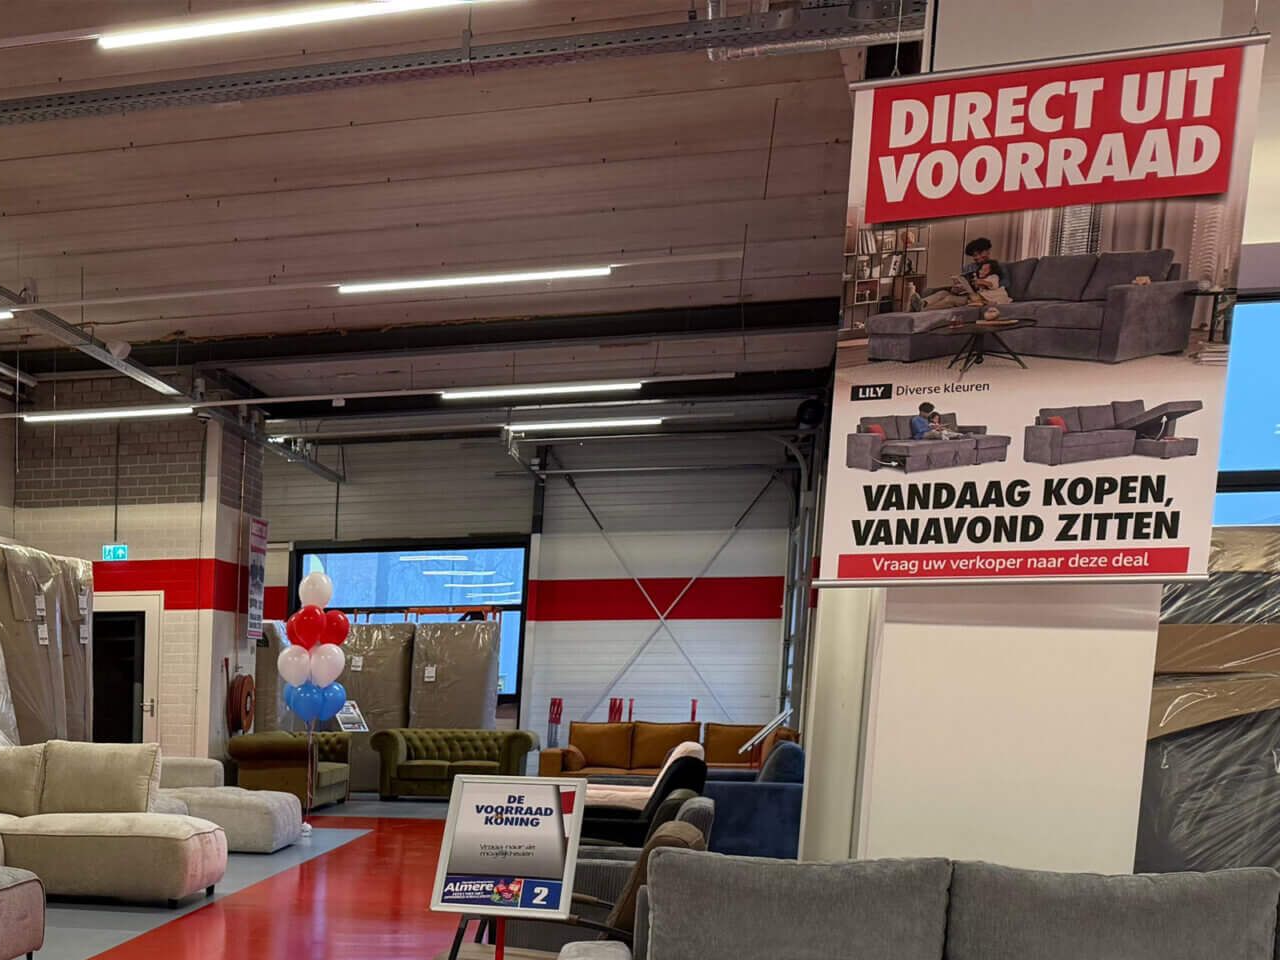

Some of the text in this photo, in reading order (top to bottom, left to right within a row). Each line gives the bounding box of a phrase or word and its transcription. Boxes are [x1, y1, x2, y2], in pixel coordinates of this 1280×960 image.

[888, 64, 1226, 149] DIRECT UIT
[877, 124, 1221, 204] VOORRAAD
[858, 383, 990, 399] LILY Diverse kleuren
[862, 474, 1175, 513] VANDAAG KOPEN,
[851, 510, 1181, 547] VANAVOND ZITTEN
[872, 552, 1149, 573] Vraag uw verkoper naar deze deal
[475, 804, 554, 817] VOORRAAD
[507, 795, 525, 805] DE
[484, 815, 541, 828] KONING
[444, 882, 549, 905] Almere 2
